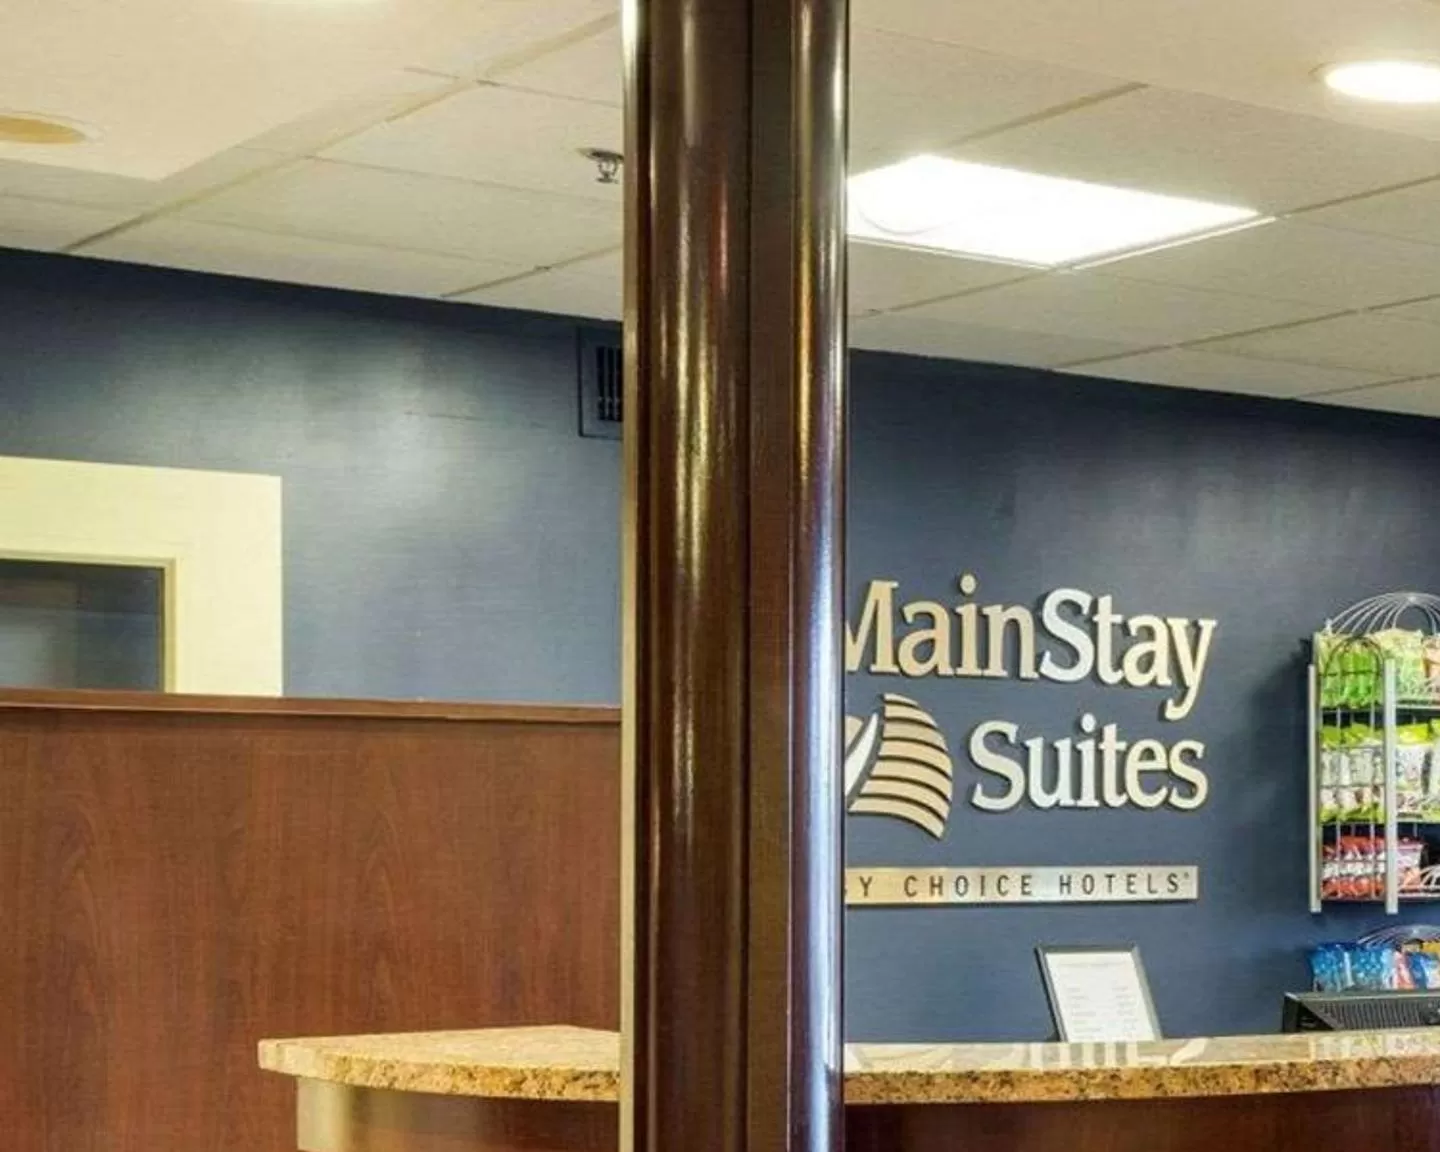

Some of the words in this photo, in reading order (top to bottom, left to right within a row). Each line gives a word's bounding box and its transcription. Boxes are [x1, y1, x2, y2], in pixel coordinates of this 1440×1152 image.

[845, 574, 1217, 721] MainStay
[970, 712, 1208, 810] Suites
[903, 874, 1033, 898] CHOICE
